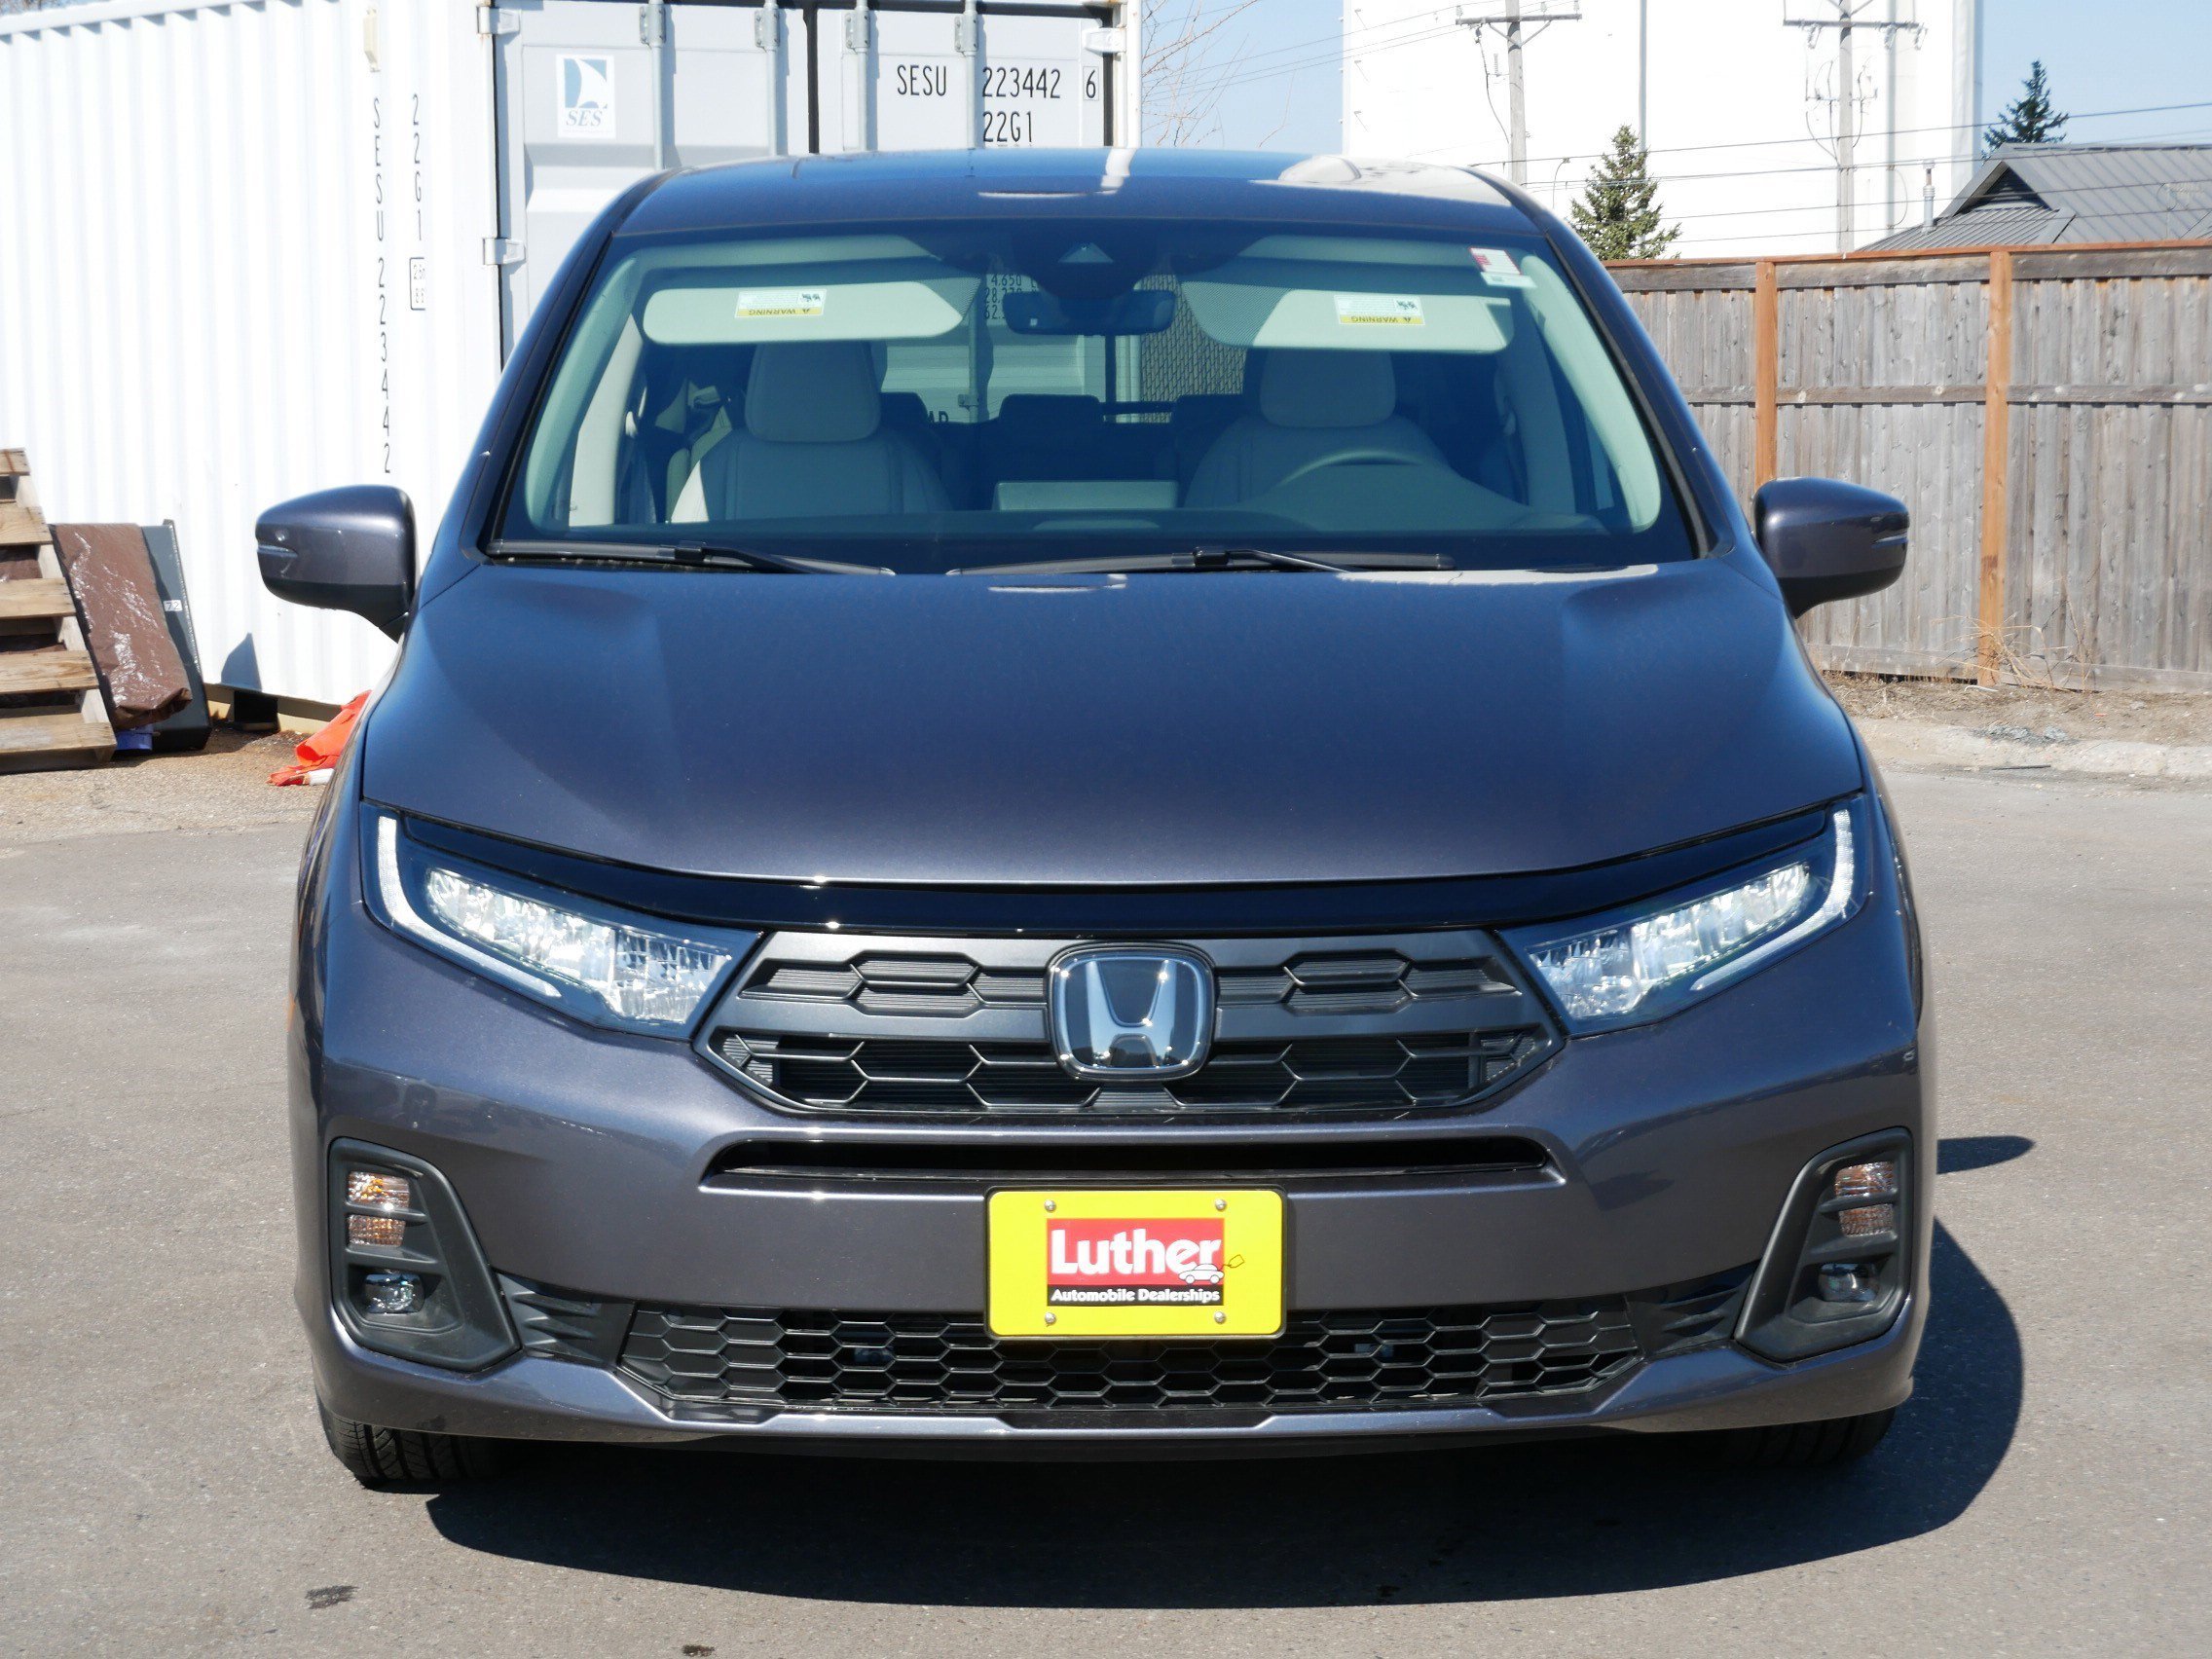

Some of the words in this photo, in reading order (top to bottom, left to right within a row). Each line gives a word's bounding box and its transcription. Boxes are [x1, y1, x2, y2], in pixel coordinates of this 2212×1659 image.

[897, 64, 947, 96] SESU
[981, 67, 1061, 98] 223442
[1085, 69, 1097, 98] 6
[566, 109, 603, 127] SES
[982, 110, 1033, 143] 22G1
[373, 96, 385, 241] SESU
[411, 93, 423, 240] 22G1
[377, 257, 391, 474] 223442
[1051, 1228, 1222, 1274] Luther
[1051, 1288, 1135, 1302] Automobile
[1138, 1289, 1220, 1304] Dealerships
